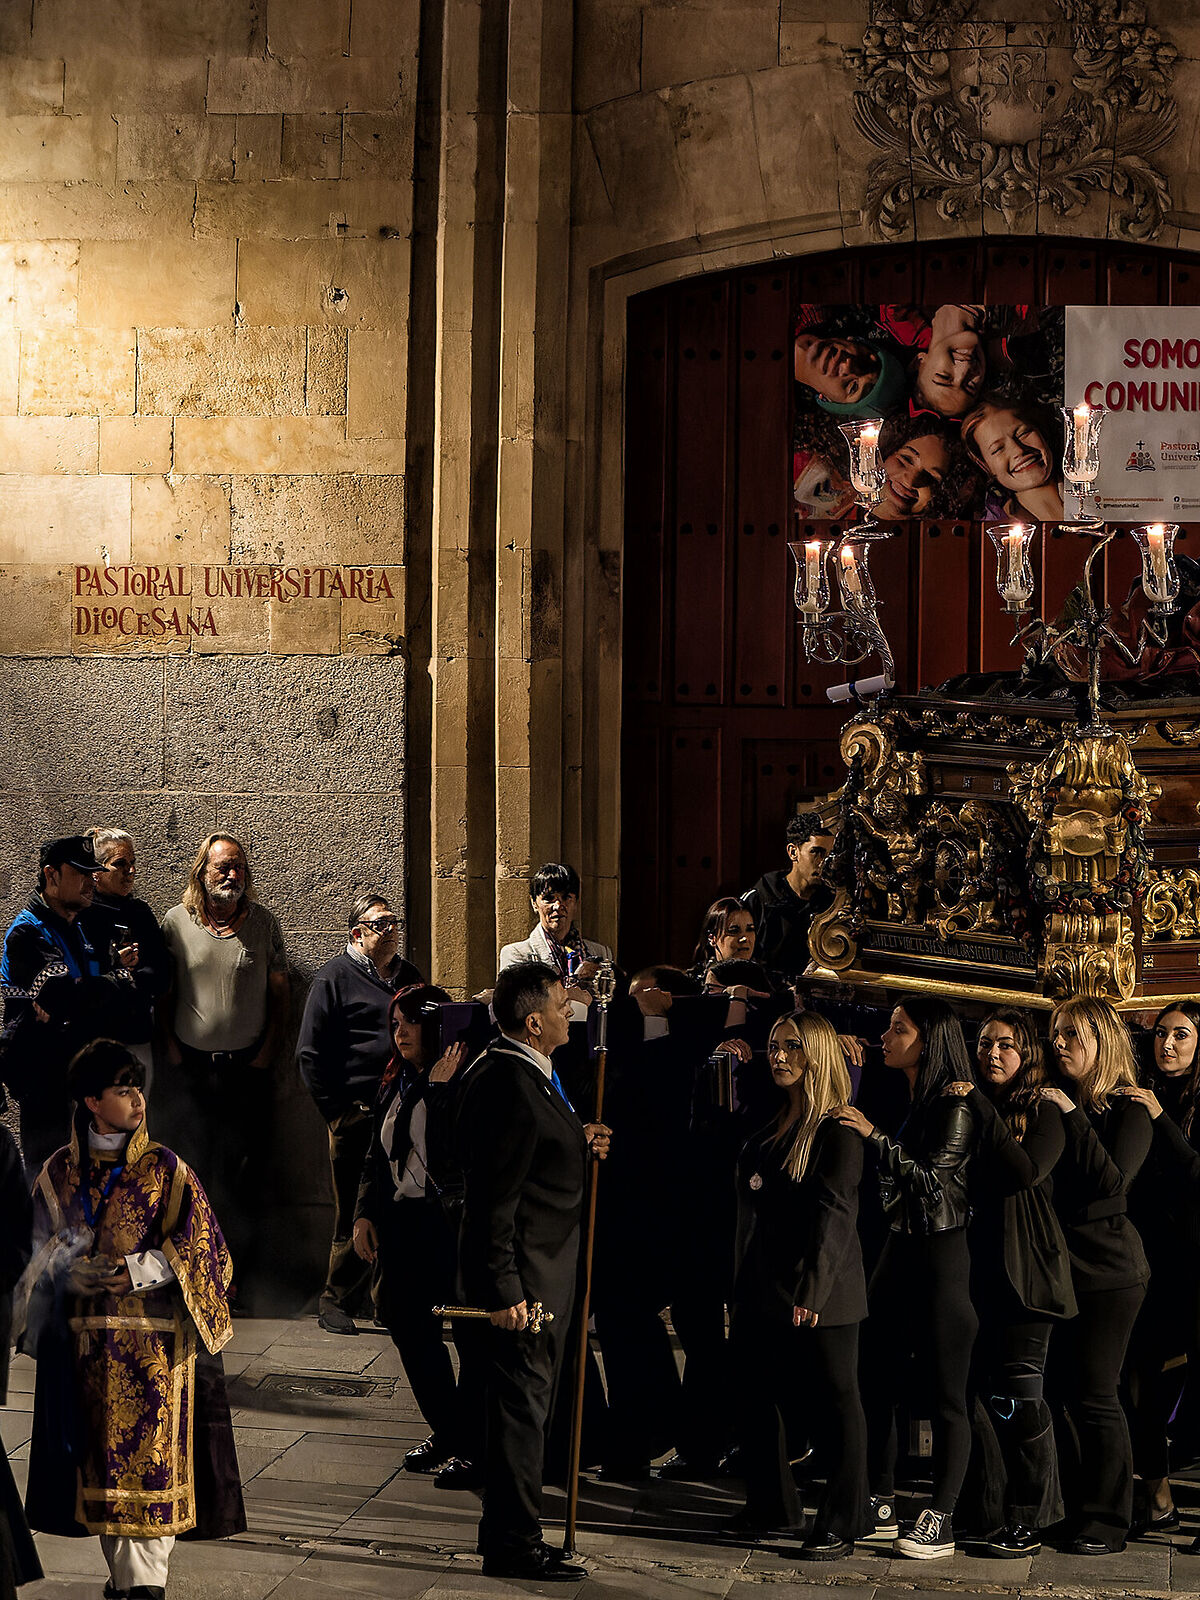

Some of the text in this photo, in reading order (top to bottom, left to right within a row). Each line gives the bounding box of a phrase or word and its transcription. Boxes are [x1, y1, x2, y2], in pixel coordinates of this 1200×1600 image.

[1160, 442, 1200, 451] Pastoral
[75, 566, 394, 603] PASTORAL UNIVERSITARIA
[75, 606, 219, 637] DIOCESANA
